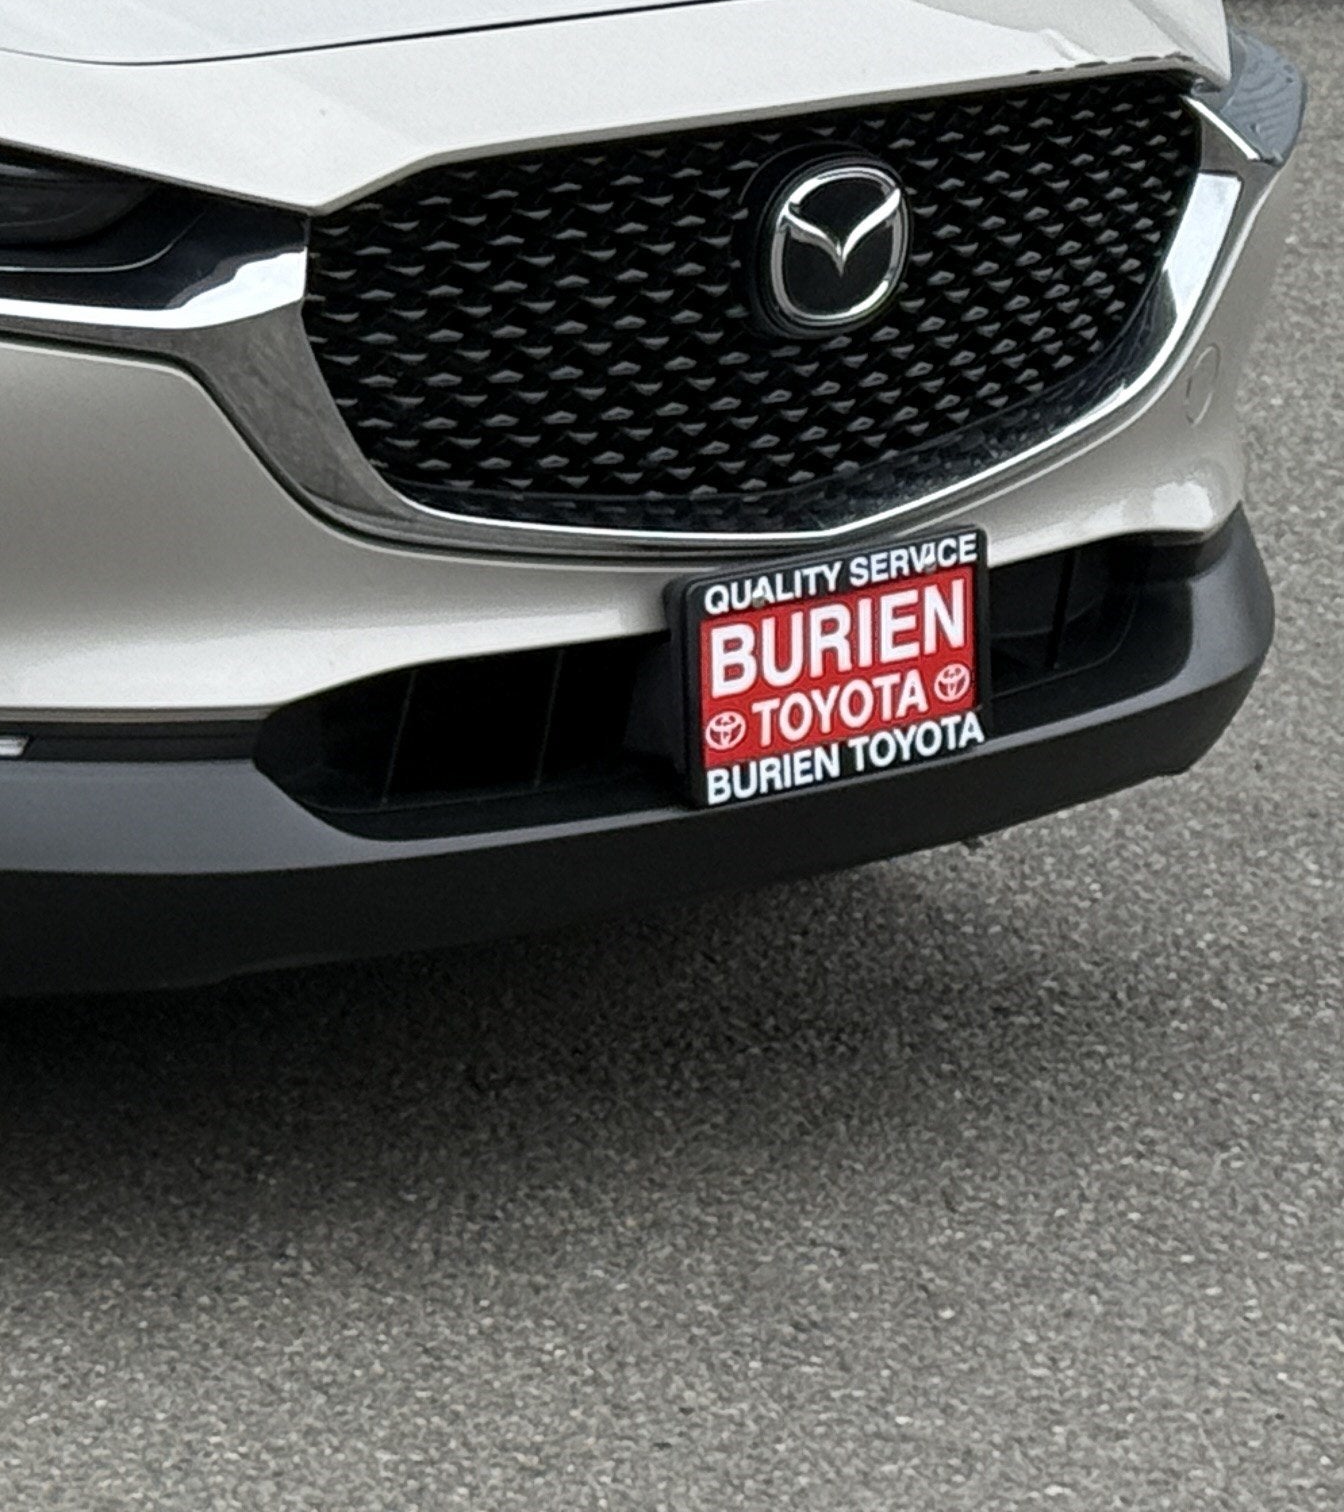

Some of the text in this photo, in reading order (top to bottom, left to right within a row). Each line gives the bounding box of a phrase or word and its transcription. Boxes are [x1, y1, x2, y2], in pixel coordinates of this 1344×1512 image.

[704, 533, 978, 615] QUALITY SERVICE
[711, 578, 965, 700] BURIEN
[751, 669, 929, 748] TOYOTA
[707, 710, 985, 806] BURIEN TOYOTA
